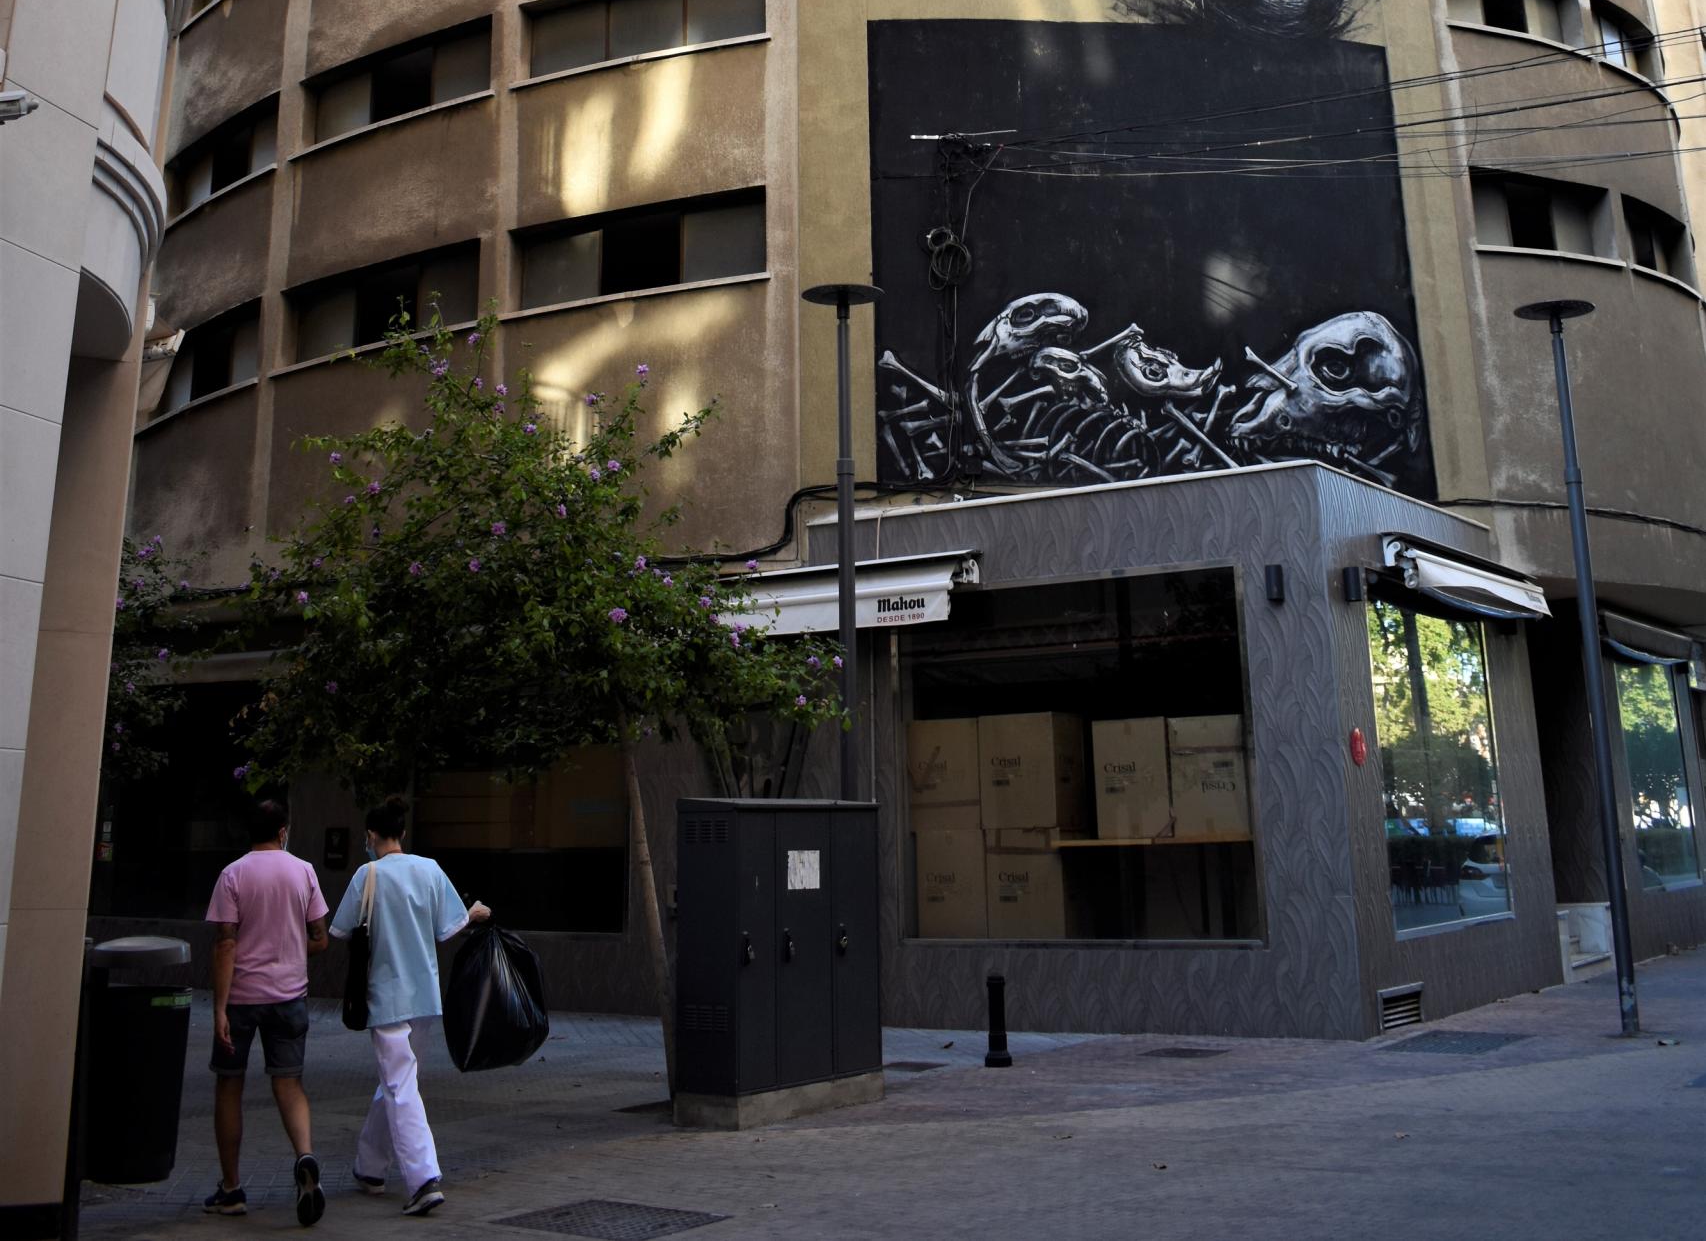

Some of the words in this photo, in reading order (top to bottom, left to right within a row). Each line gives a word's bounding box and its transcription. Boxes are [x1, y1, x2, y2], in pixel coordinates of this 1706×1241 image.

[877, 596, 925, 612] Mahou
[877, 615, 905, 623] DESDE
[908, 612, 925, 620] 1890
[990, 755, 1021, 768] Crisal
[1103, 761, 1136, 774] Crisal
[1201, 781, 1236, 794] Crisal
[926, 871, 956, 883] Crisal
[998, 871, 1029, 883] Crisal
